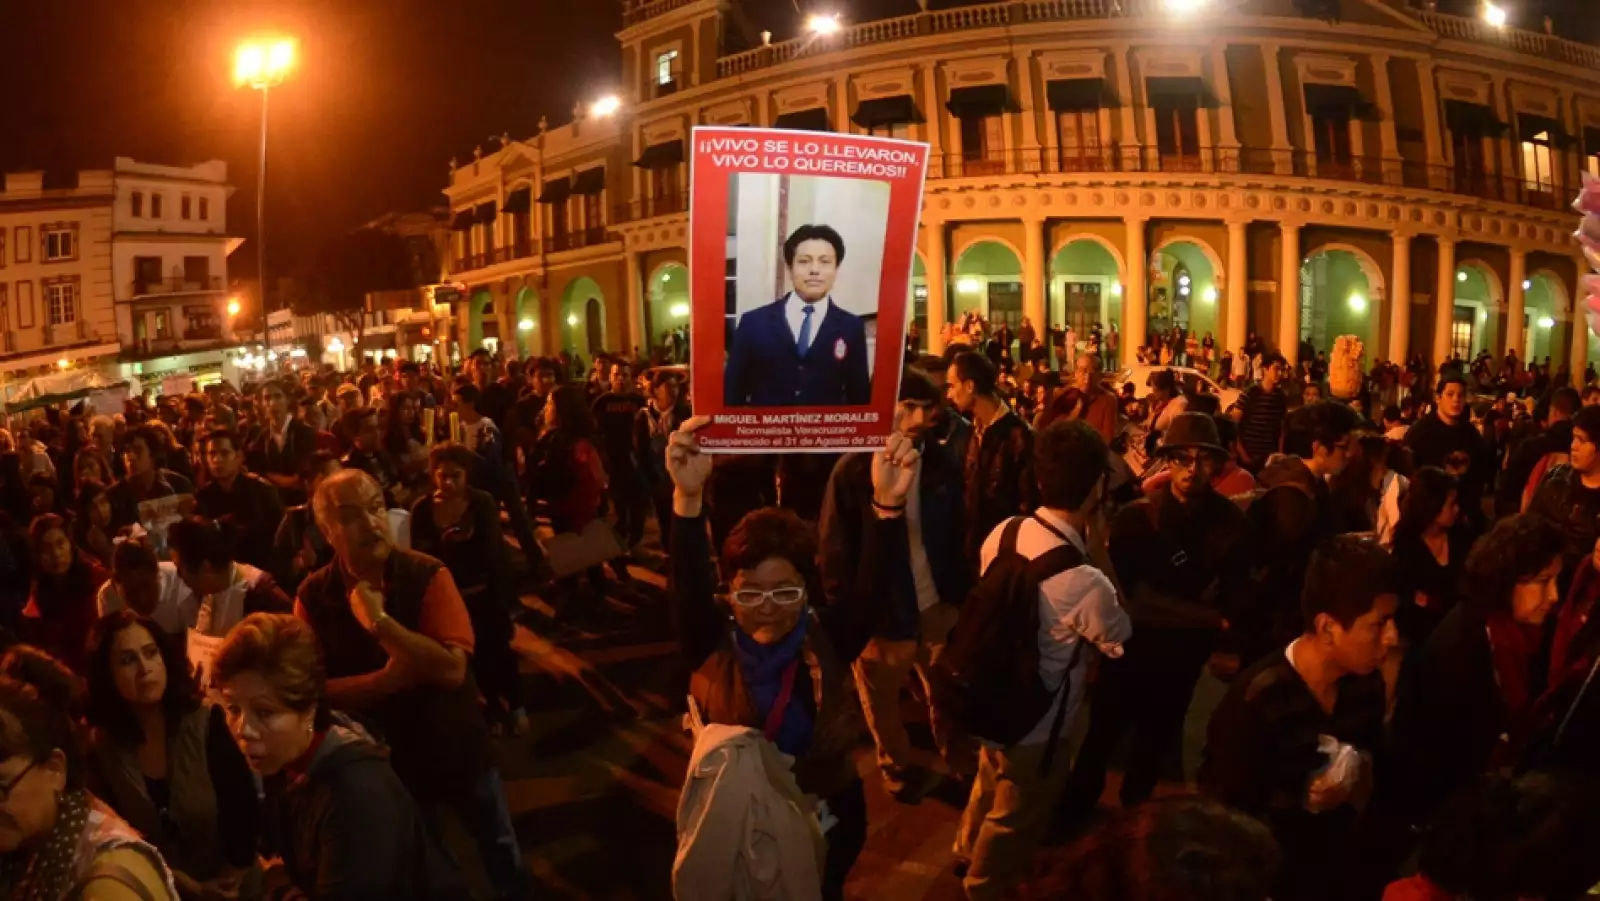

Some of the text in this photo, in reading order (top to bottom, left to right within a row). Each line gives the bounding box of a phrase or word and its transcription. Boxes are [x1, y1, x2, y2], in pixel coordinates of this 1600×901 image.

[700, 138, 919, 166] ¡¡VIVO SE LO LLEVARON,
[712, 155, 907, 179] VIVO LO QUEREMOS!!
[714, 412, 879, 425] MIGUEL MARTÍNEZ MORALES
[736, 426, 857, 436] Normalista Veracruzano
[700, 436, 771, 447] Desaparecido
[773, 436, 782, 446] el
[785, 436, 797, 446] 31
[800, 436, 813, 446] de
[815, 436, 850, 447] Agosto
[851, 436, 865, 446] de
